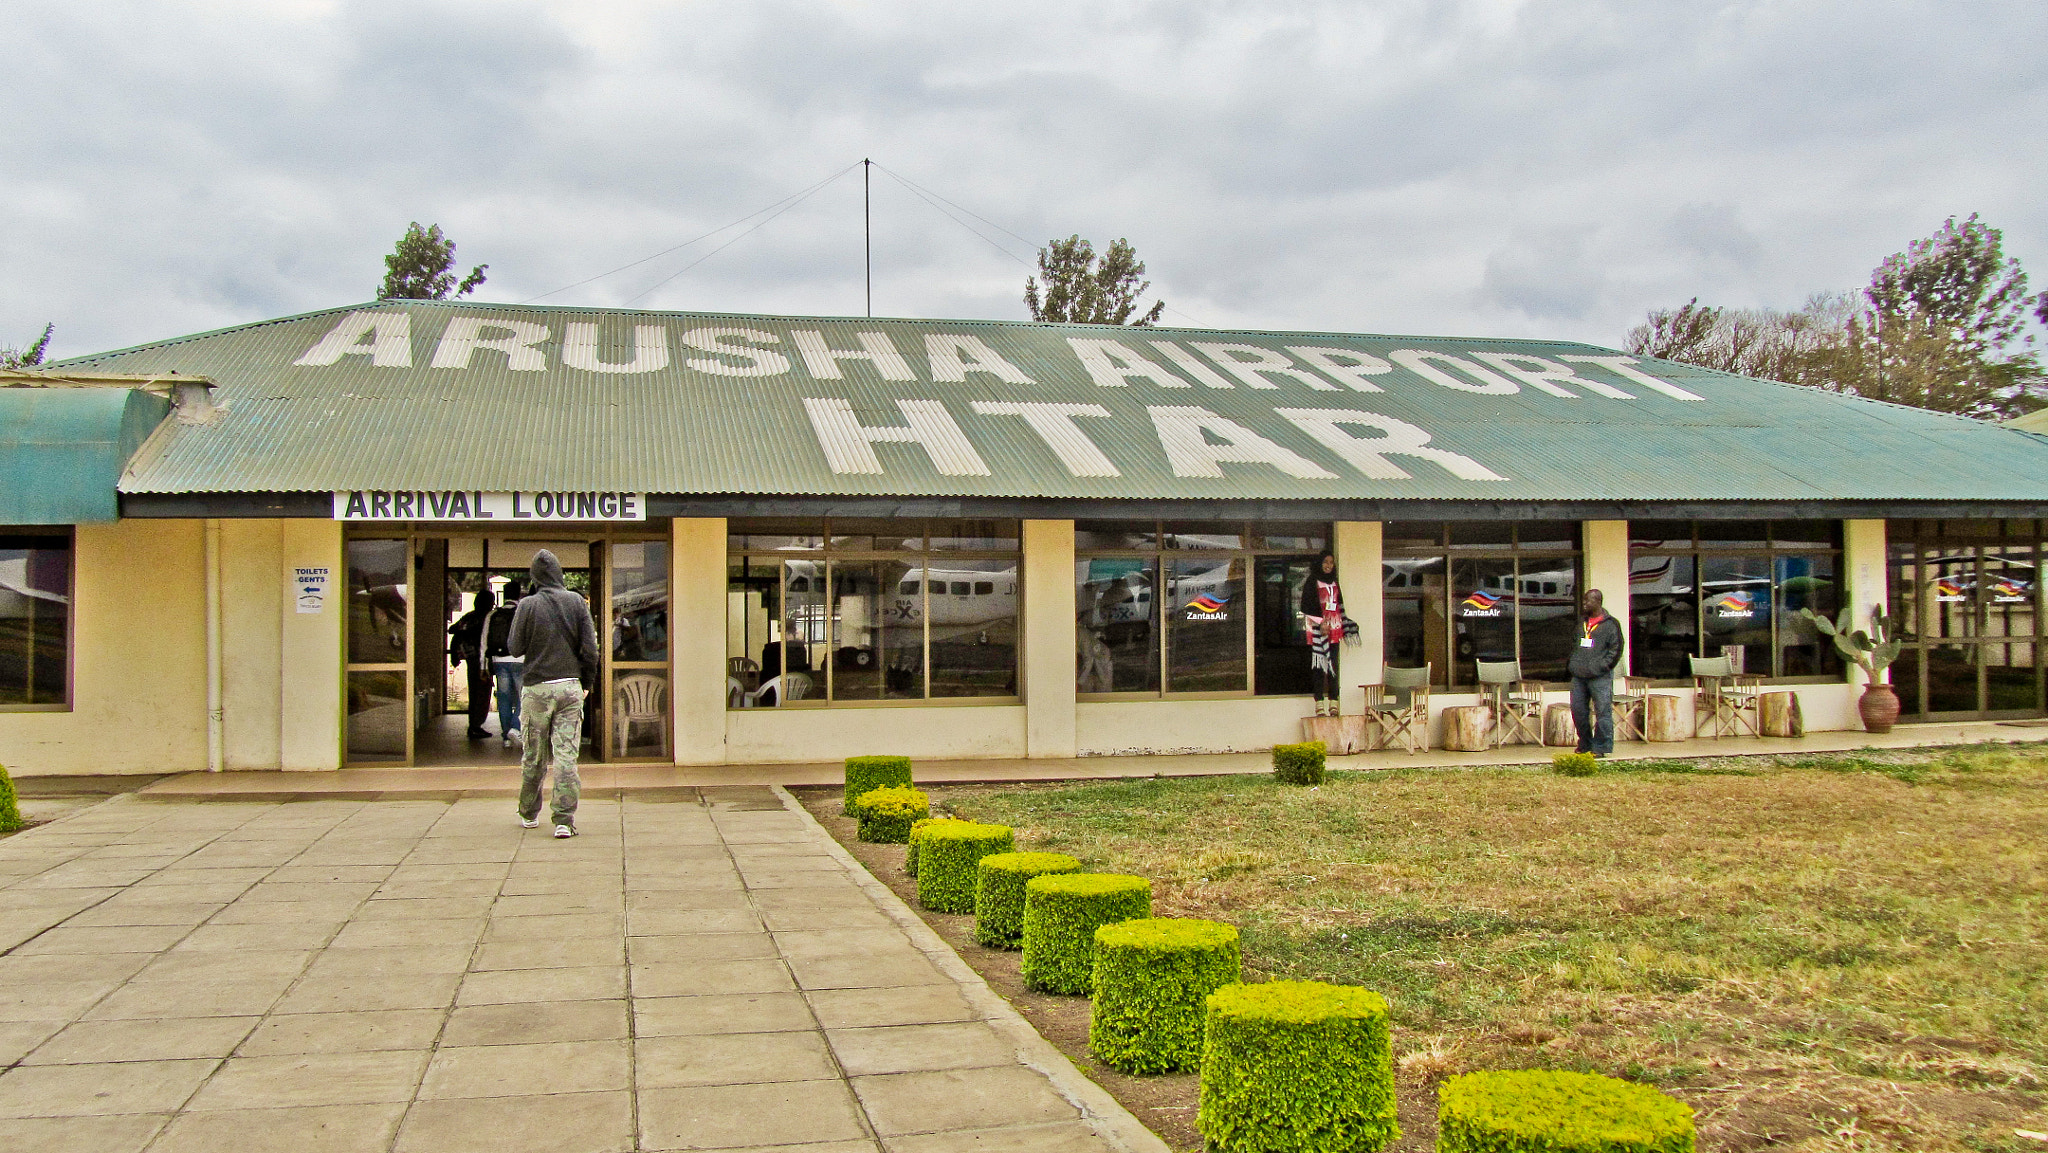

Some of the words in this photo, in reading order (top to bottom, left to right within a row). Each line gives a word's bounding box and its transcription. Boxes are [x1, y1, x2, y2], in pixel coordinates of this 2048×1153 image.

[294, 311, 1037, 385] ARUSHA
[1065, 336, 1705, 401] AIRPORT
[802, 397, 1510, 481] HTAR
[345, 491, 493, 518] ARRIVAL
[512, 492, 637, 518] LOUNGE
[1186, 611, 1228, 621] ZantasAir
[1463, 608, 1501, 617] ZantasAir
